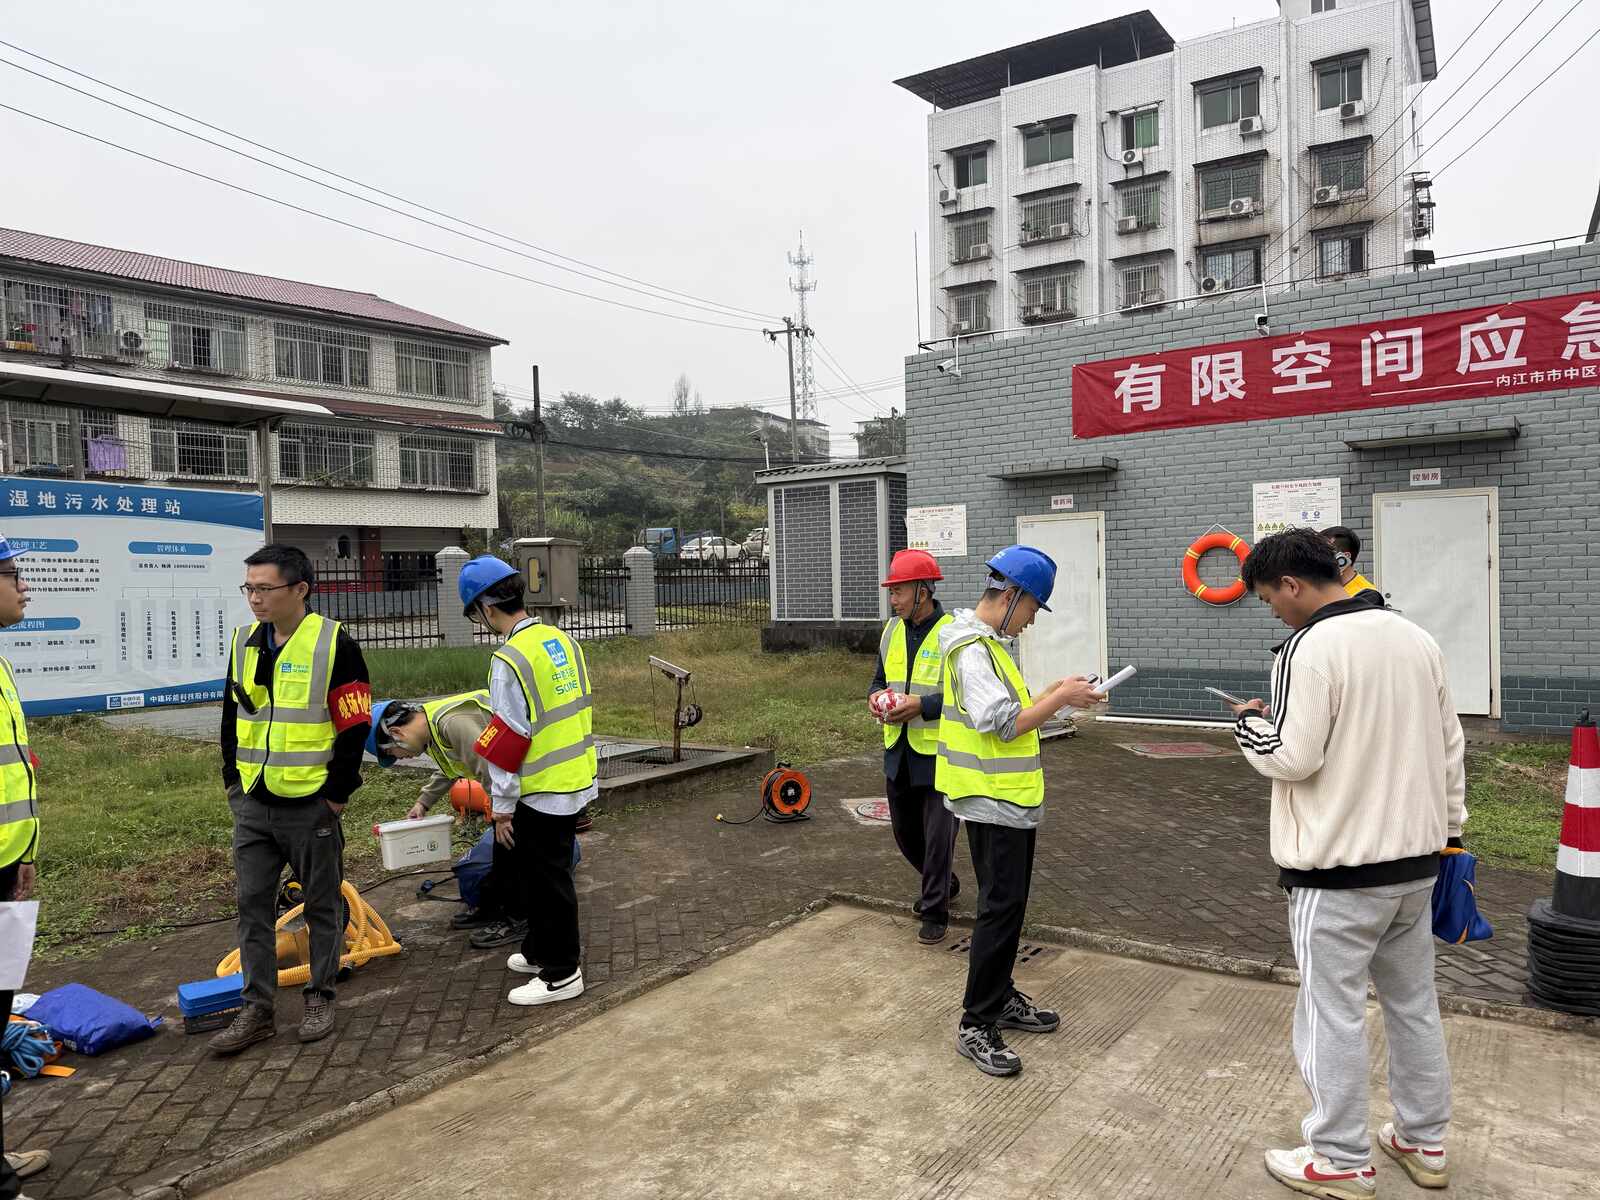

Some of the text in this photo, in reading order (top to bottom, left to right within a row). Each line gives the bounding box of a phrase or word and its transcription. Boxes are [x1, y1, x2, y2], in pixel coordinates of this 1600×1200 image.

[1113, 301, 1600, 414] 有限空间应急
[1496, 365, 1600, 387] 内江市市中区
[9, 490, 181, 515] 湿地污水处理站
[9, 541, 47, 550] 处理工艺
